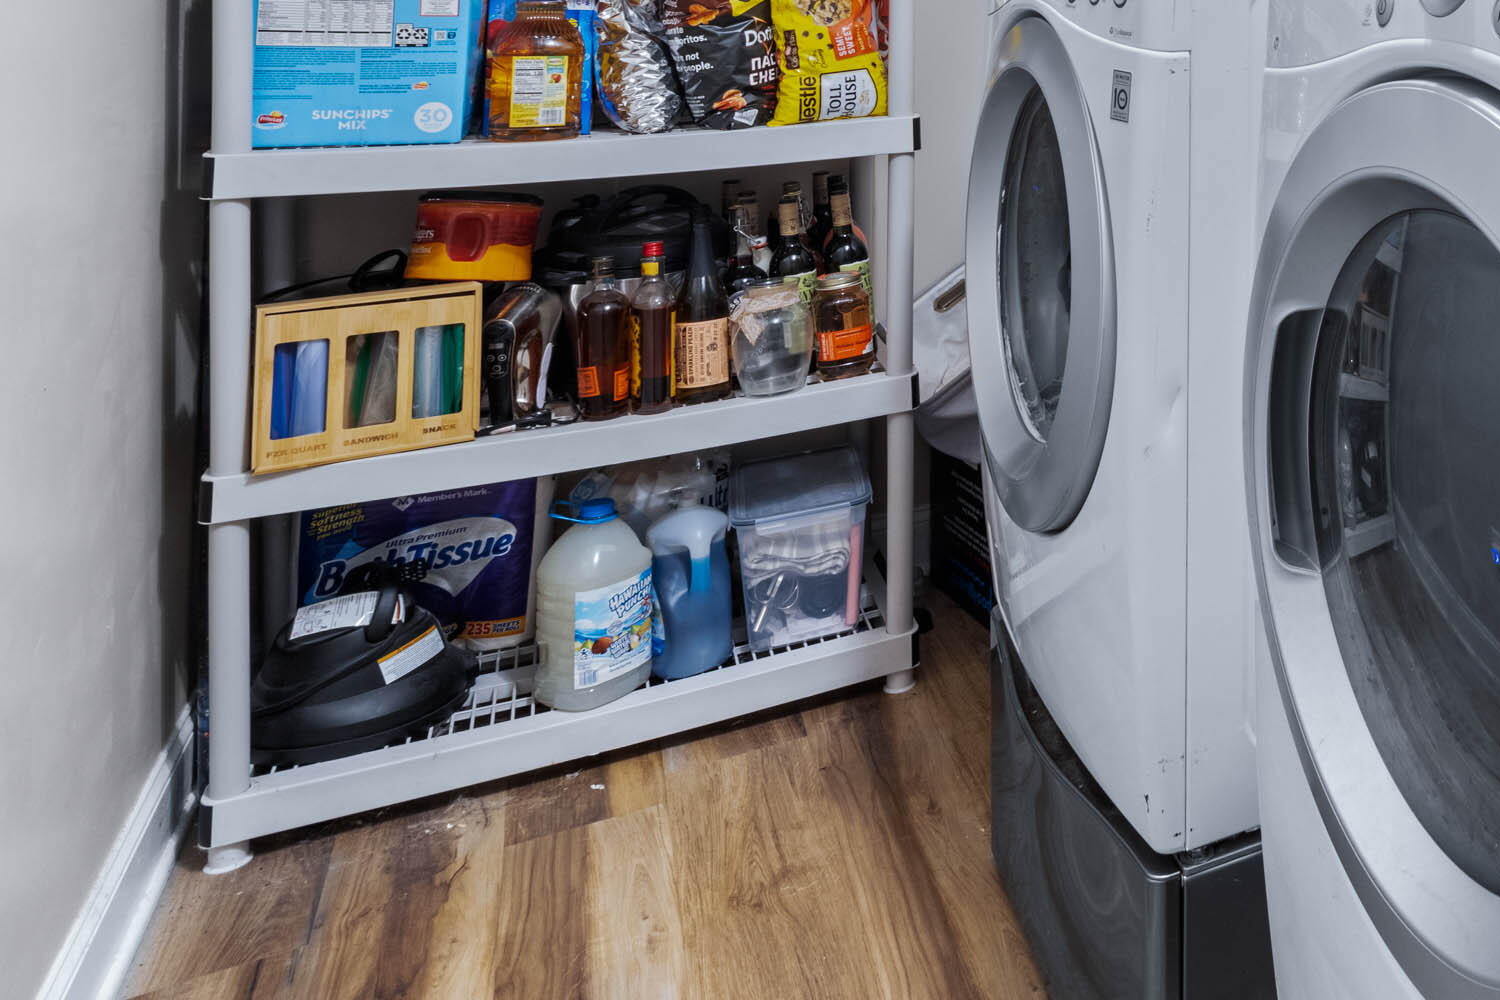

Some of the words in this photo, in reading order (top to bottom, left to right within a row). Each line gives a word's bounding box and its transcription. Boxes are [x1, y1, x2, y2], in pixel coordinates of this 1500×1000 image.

[841, 25, 856, 55] SWEET
[685, 52, 700, 61] not
[826, 83, 842, 116] TOLL
[312, 109, 389, 121] SUNCHIPS
[419, 109, 447, 123] 30
[337, 119, 367, 131] MIX
[422, 423, 457, 435] SNACK
[343, 432, 399, 447] SANDWICH
[290, 443, 328, 456] QUART
[417, 491, 463, 504] Member's
[464, 487, 488, 497] Mark
[385, 536, 414, 548] Ultra
[415, 526, 467, 542] Premium
[405, 532, 515, 571] Tissue
[615, 584, 651, 618] PUNCH
[467, 622, 491, 635] 235
